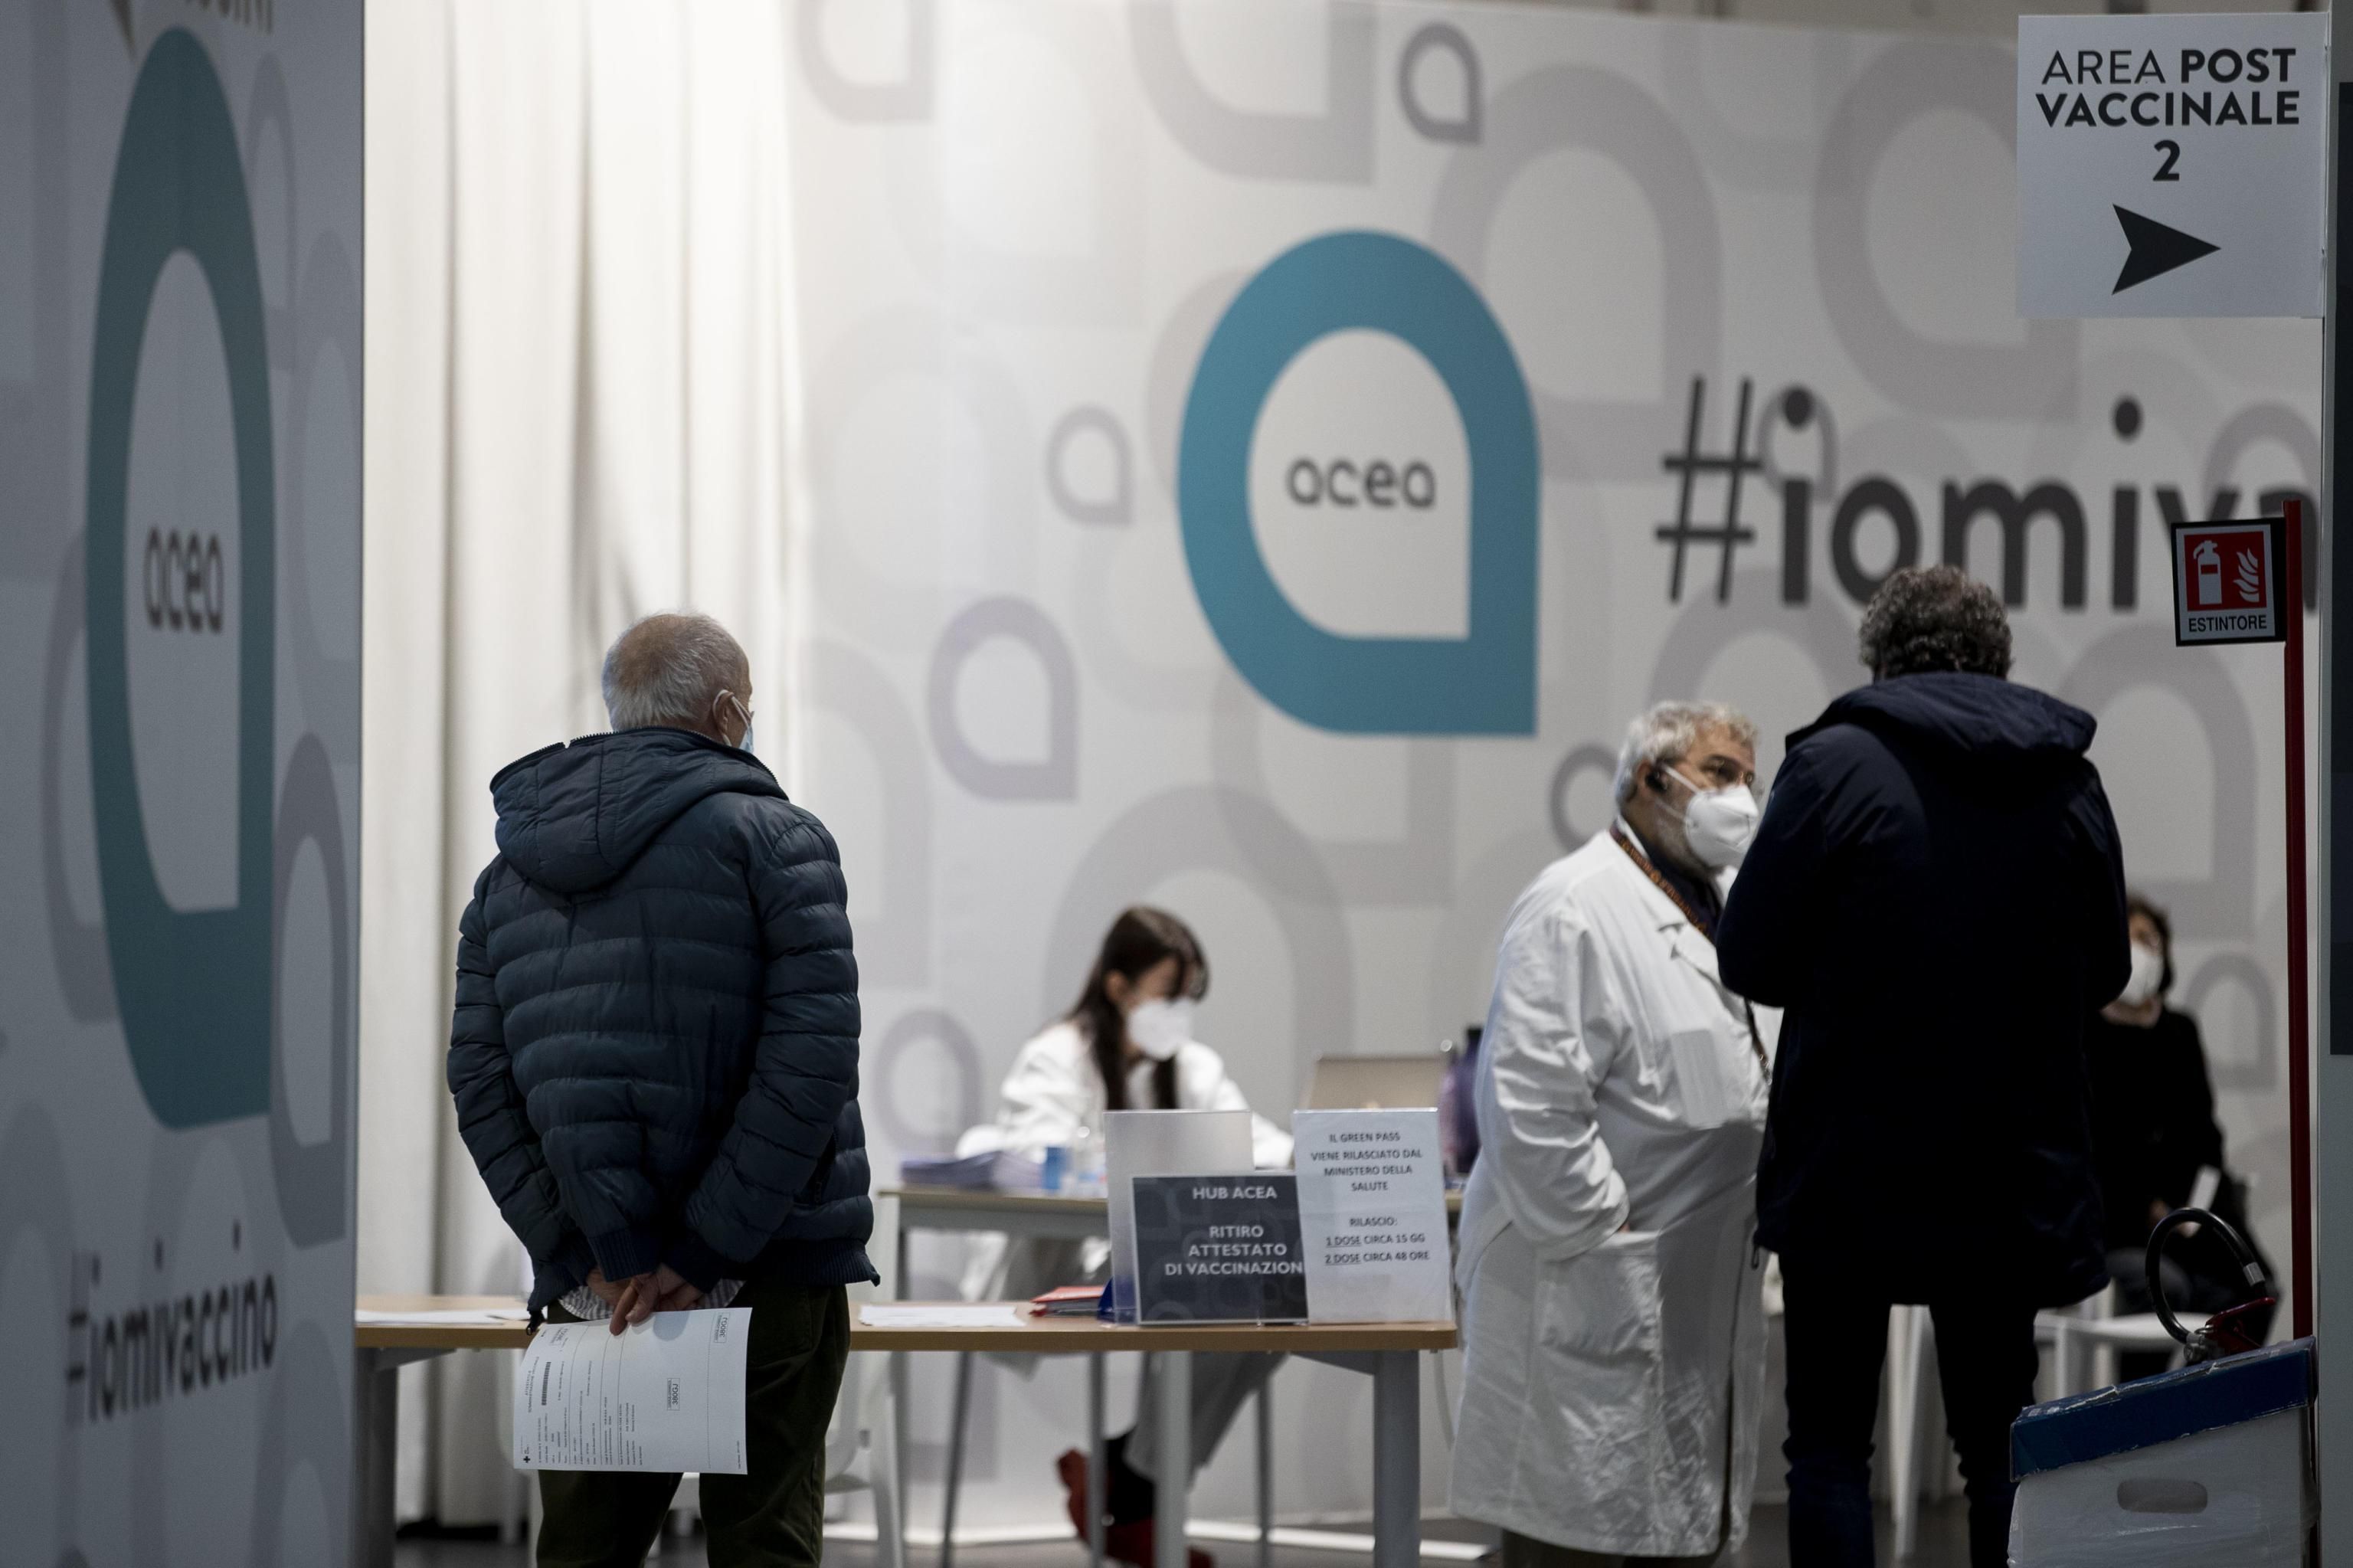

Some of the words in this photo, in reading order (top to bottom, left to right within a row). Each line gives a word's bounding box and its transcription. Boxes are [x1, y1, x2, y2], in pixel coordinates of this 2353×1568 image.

[2041, 49, 2166, 84] AREA
[2181, 48, 2296, 83] POST
[2035, 90, 2299, 128] VACCINALE
[2152, 139, 2181, 182] 2
[1285, 458, 1437, 509] acea
[142, 524, 224, 635] acea
[2188, 615, 2267, 633] ESTINTORE
[1329, 1134, 1337, 1143] IL
[1340, 1132, 1373, 1143] GREEN
[1376, 1131, 1401, 1142] PASS
[1311, 1151, 1340, 1161] VIENE
[1343, 1150, 1400, 1160] RILASCIATO
[1402, 1149, 1423, 1159] DAL
[1324, 1166, 1379, 1177] MINISTERO
[1383, 1164, 1412, 1175] DELLA
[1193, 1187, 1229, 1200] HUB
[1232, 1186, 1278, 1199] ACEA
[1351, 1181, 1389, 1191] SALUTE
[1349, 1217, 1398, 1227] RILASCIO:
[1209, 1225, 1265, 1239] RITIRO
[1334, 1236, 1361, 1246] DOSE
[1364, 1235, 1393, 1244] CIRCA
[1396, 1233, 1408, 1243] 15
[1409, 1232, 1425, 1242] GG
[1189, 1243, 1288, 1257] ATTESTATO
[1334, 1254, 1360, 1264] DOSE
[1363, 1252, 1392, 1262] CIRCA
[1395, 1252, 1407, 1261] 48
[1409, 1251, 1430, 1261] ORE
[1165, 1264, 1183, 1275] DI
[67, 1218, 277, 1426] #iomivaccino
[719, 1317, 728, 1337] 380GJ
